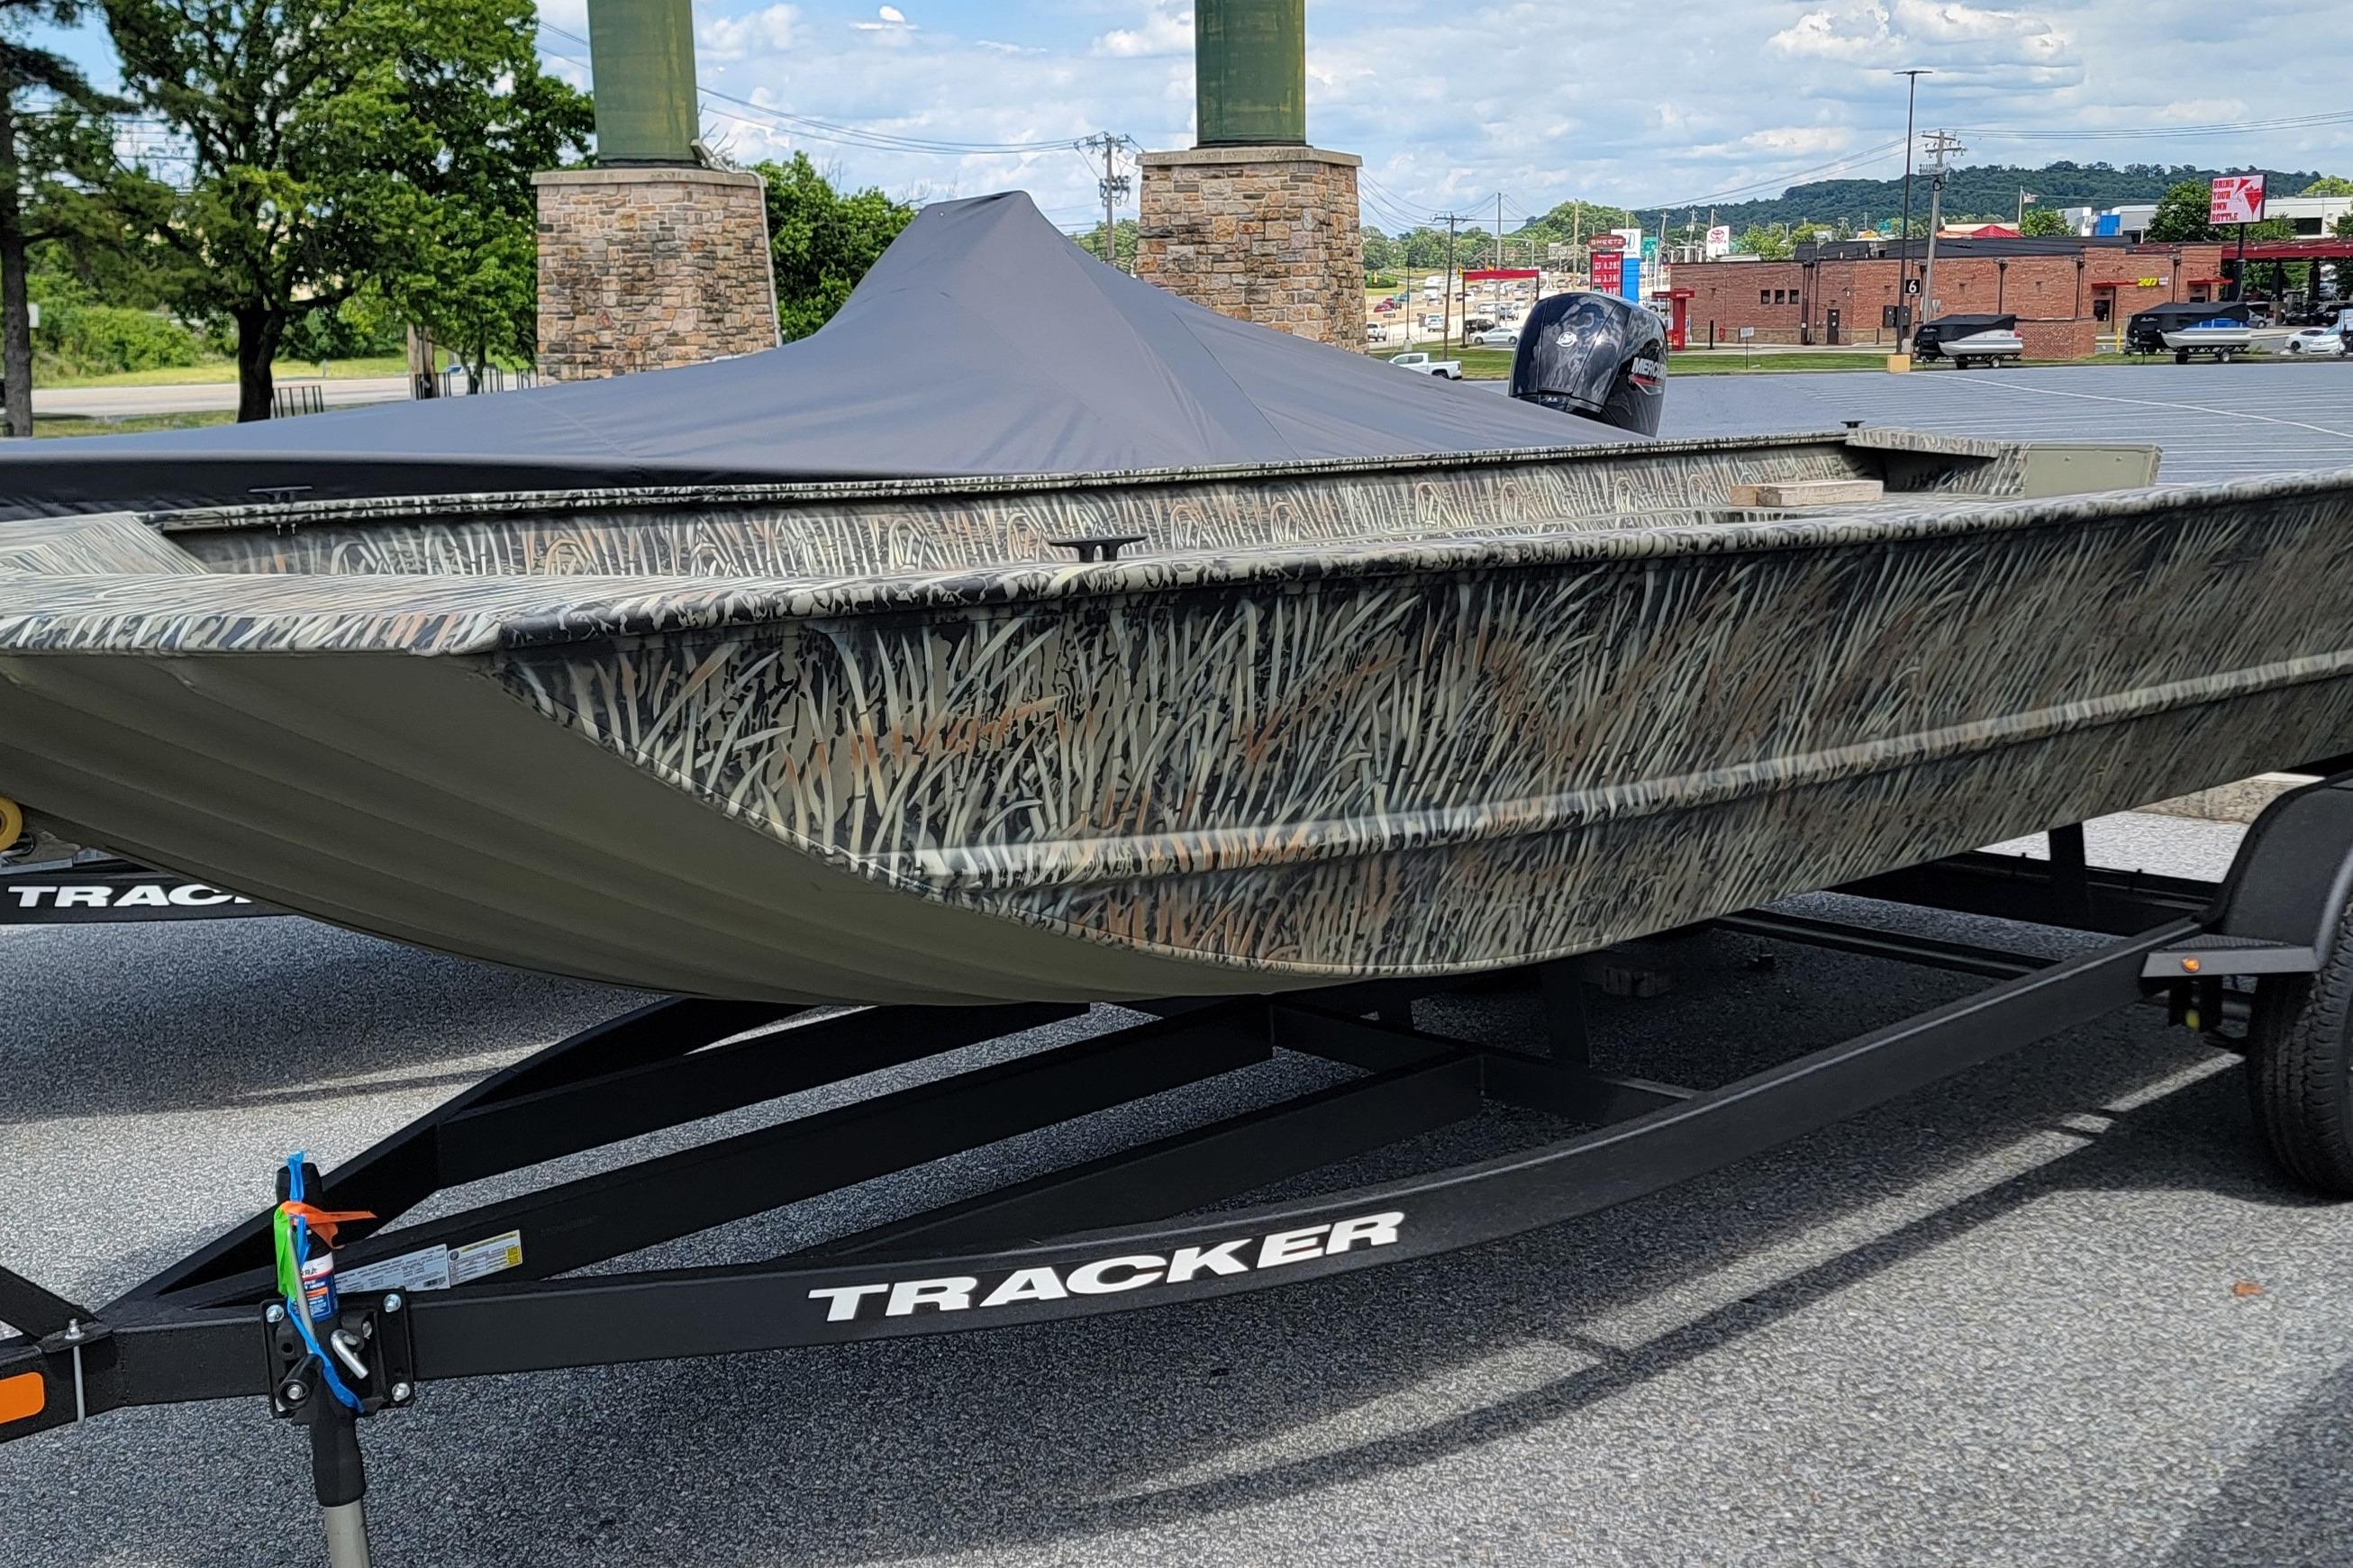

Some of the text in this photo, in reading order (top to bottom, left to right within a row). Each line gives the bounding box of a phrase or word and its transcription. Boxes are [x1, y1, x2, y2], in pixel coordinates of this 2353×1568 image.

[2213, 179, 2234, 188] BRING
[2213, 191, 2230, 199] YOUR
[2212, 202, 2228, 211] OWN
[2212, 213, 2239, 222] BOTTLE
[1908, 280, 1917, 293] 6
[808, 1210, 1405, 1323] TRACKER
